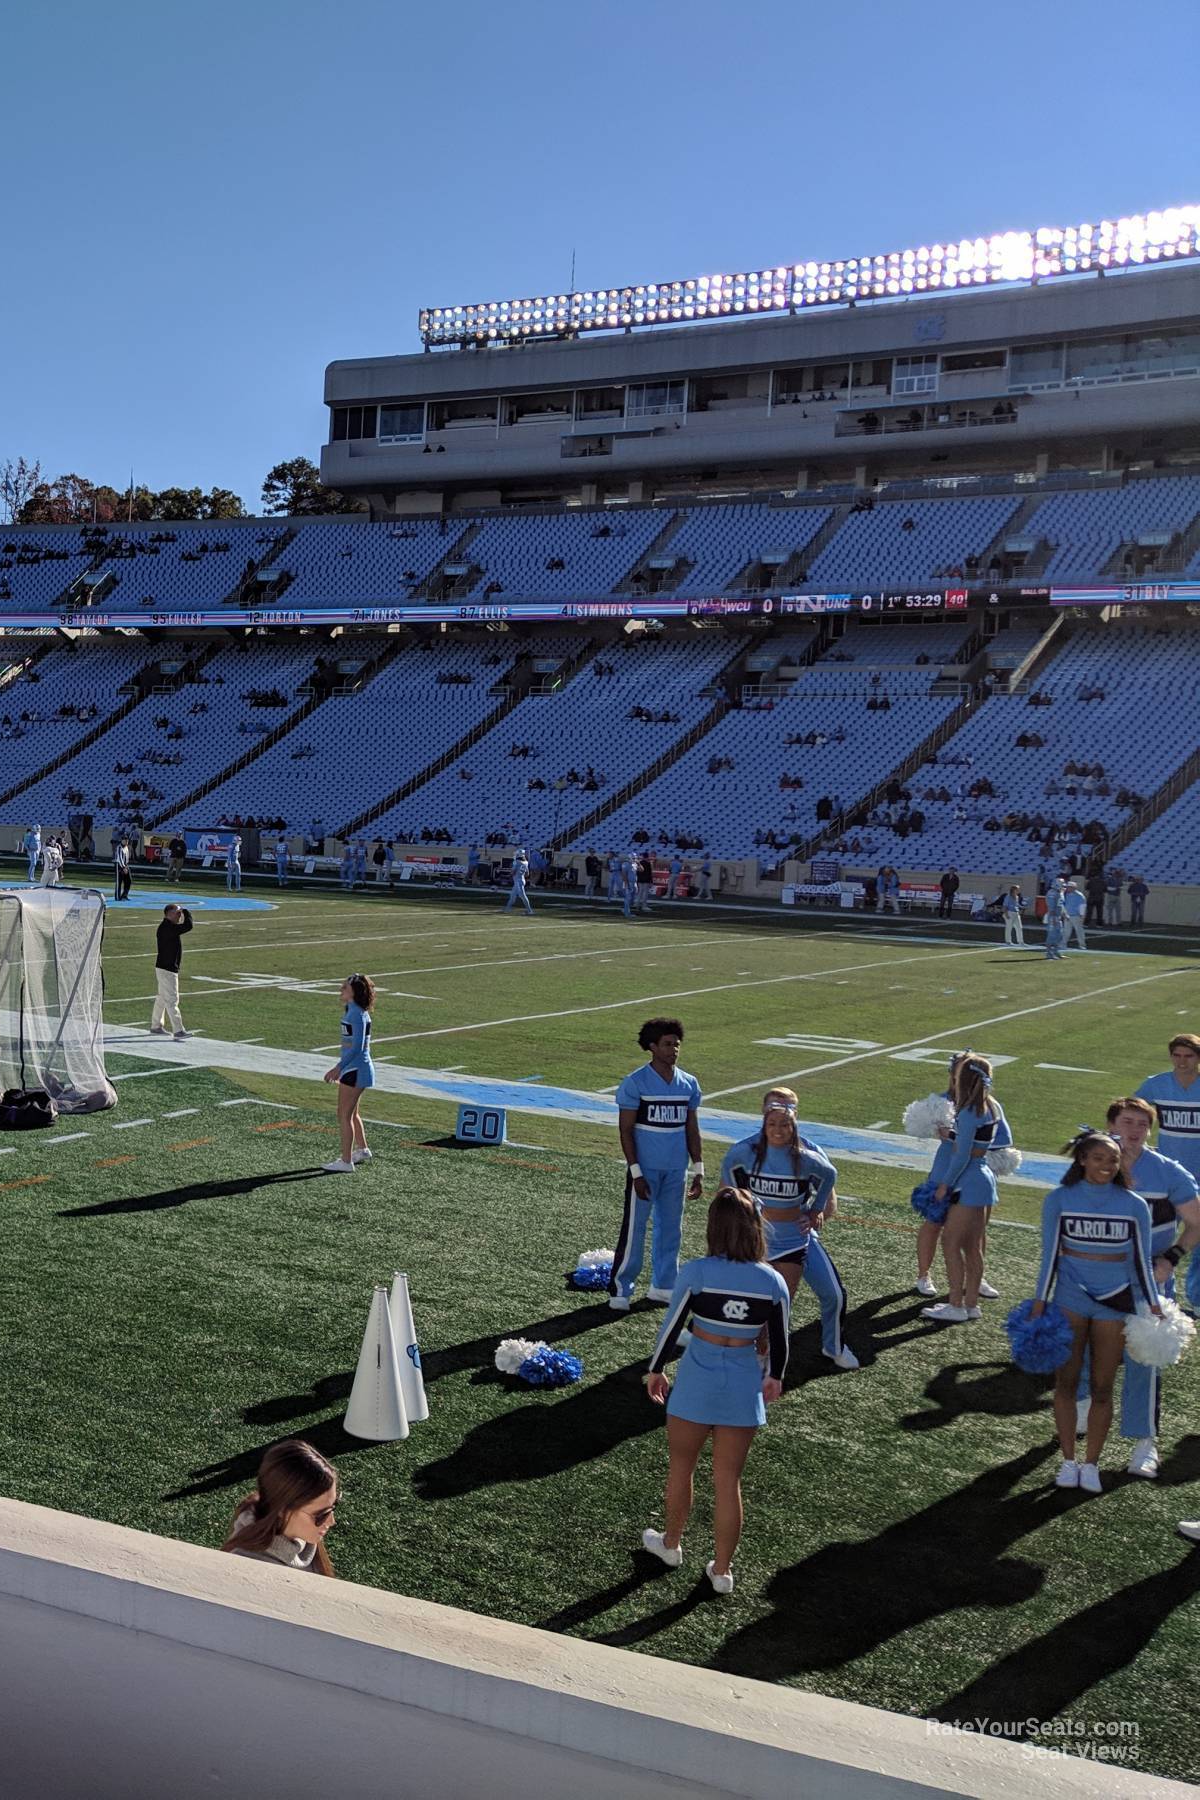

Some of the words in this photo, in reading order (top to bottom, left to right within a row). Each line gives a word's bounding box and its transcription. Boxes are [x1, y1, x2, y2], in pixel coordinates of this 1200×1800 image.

[727, 601, 751, 612] WCU
[762, 598, 773, 613] 0
[825, 597, 850, 609] UNC
[861, 594, 872, 610] 0
[905, 594, 942, 608] 53:29
[948, 593, 964, 605] 40
[249, 611, 261, 623] 12
[262, 611, 301, 623] HORTON
[353, 609, 366, 621] 71
[368, 609, 401, 621] JONES
[460, 607, 476, 619] 87
[478, 606, 508, 619] ELLIS
[576, 604, 633, 617] SIMMONS
[60, 614, 74, 625] 98
[75, 614, 110, 625] TAYLOR
[152, 614, 167, 625] 95
[648, 1104, 688, 1123] CAROLIN
[461, 1110, 500, 1139] 20
[749, 1178, 799, 1197] CAROLINA
[1065, 1218, 1129, 1240] CAROLINA
